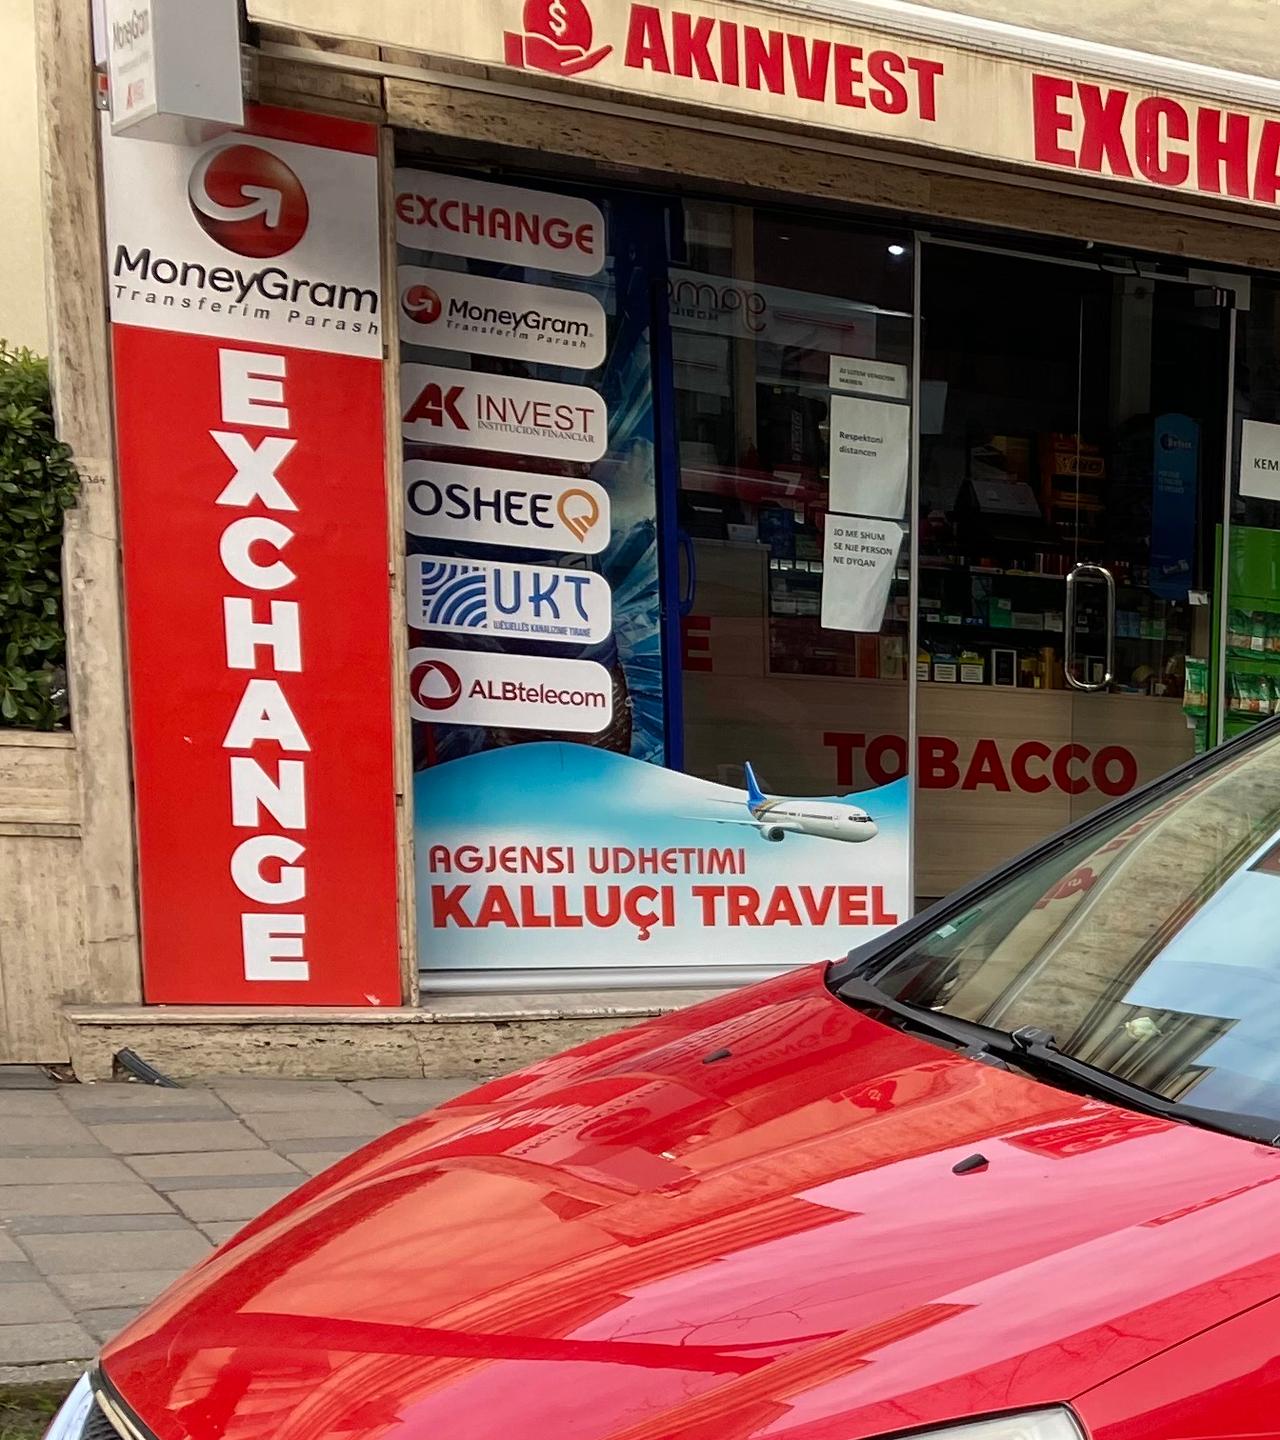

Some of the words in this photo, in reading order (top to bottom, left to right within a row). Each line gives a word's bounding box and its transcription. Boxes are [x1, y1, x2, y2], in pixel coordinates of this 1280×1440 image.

[624, 4, 944, 122] AKINVEST
[395, 193, 593, 254] EXCHANGE
[113, 244, 379, 315] MoneyGram
[115, 285, 271, 320] Transferim
[287, 308, 380, 336] Parash
[448, 298, 589, 338] MoneyGram
[446, 320, 529, 341] Transferim
[537, 333, 587, 348] Parash
[476, 393, 595, 433] INVEST
[477, 420, 540, 437] INSTITUCION
[542, 428, 595, 444] FINANCIAR
[407, 479, 555, 529] OSHEE
[845, 530, 858, 538] ME
[860, 531, 886, 541] SHUM
[860, 545, 894, 556] PERSON
[846, 557, 876, 568] DYQAN
[493, 568, 591, 623] UKT
[208, 346, 311, 983] EXCHANGE
[468, 679, 606, 708] ALBtelecom
[823, 731, 1138, 796] TOBACCO
[429, 844, 575, 876] AGJENSI
[588, 846, 746, 876] UDHETIMI
[431, 884, 676, 941] KALLUÇI
[693, 884, 898, 928] TRAVEL
